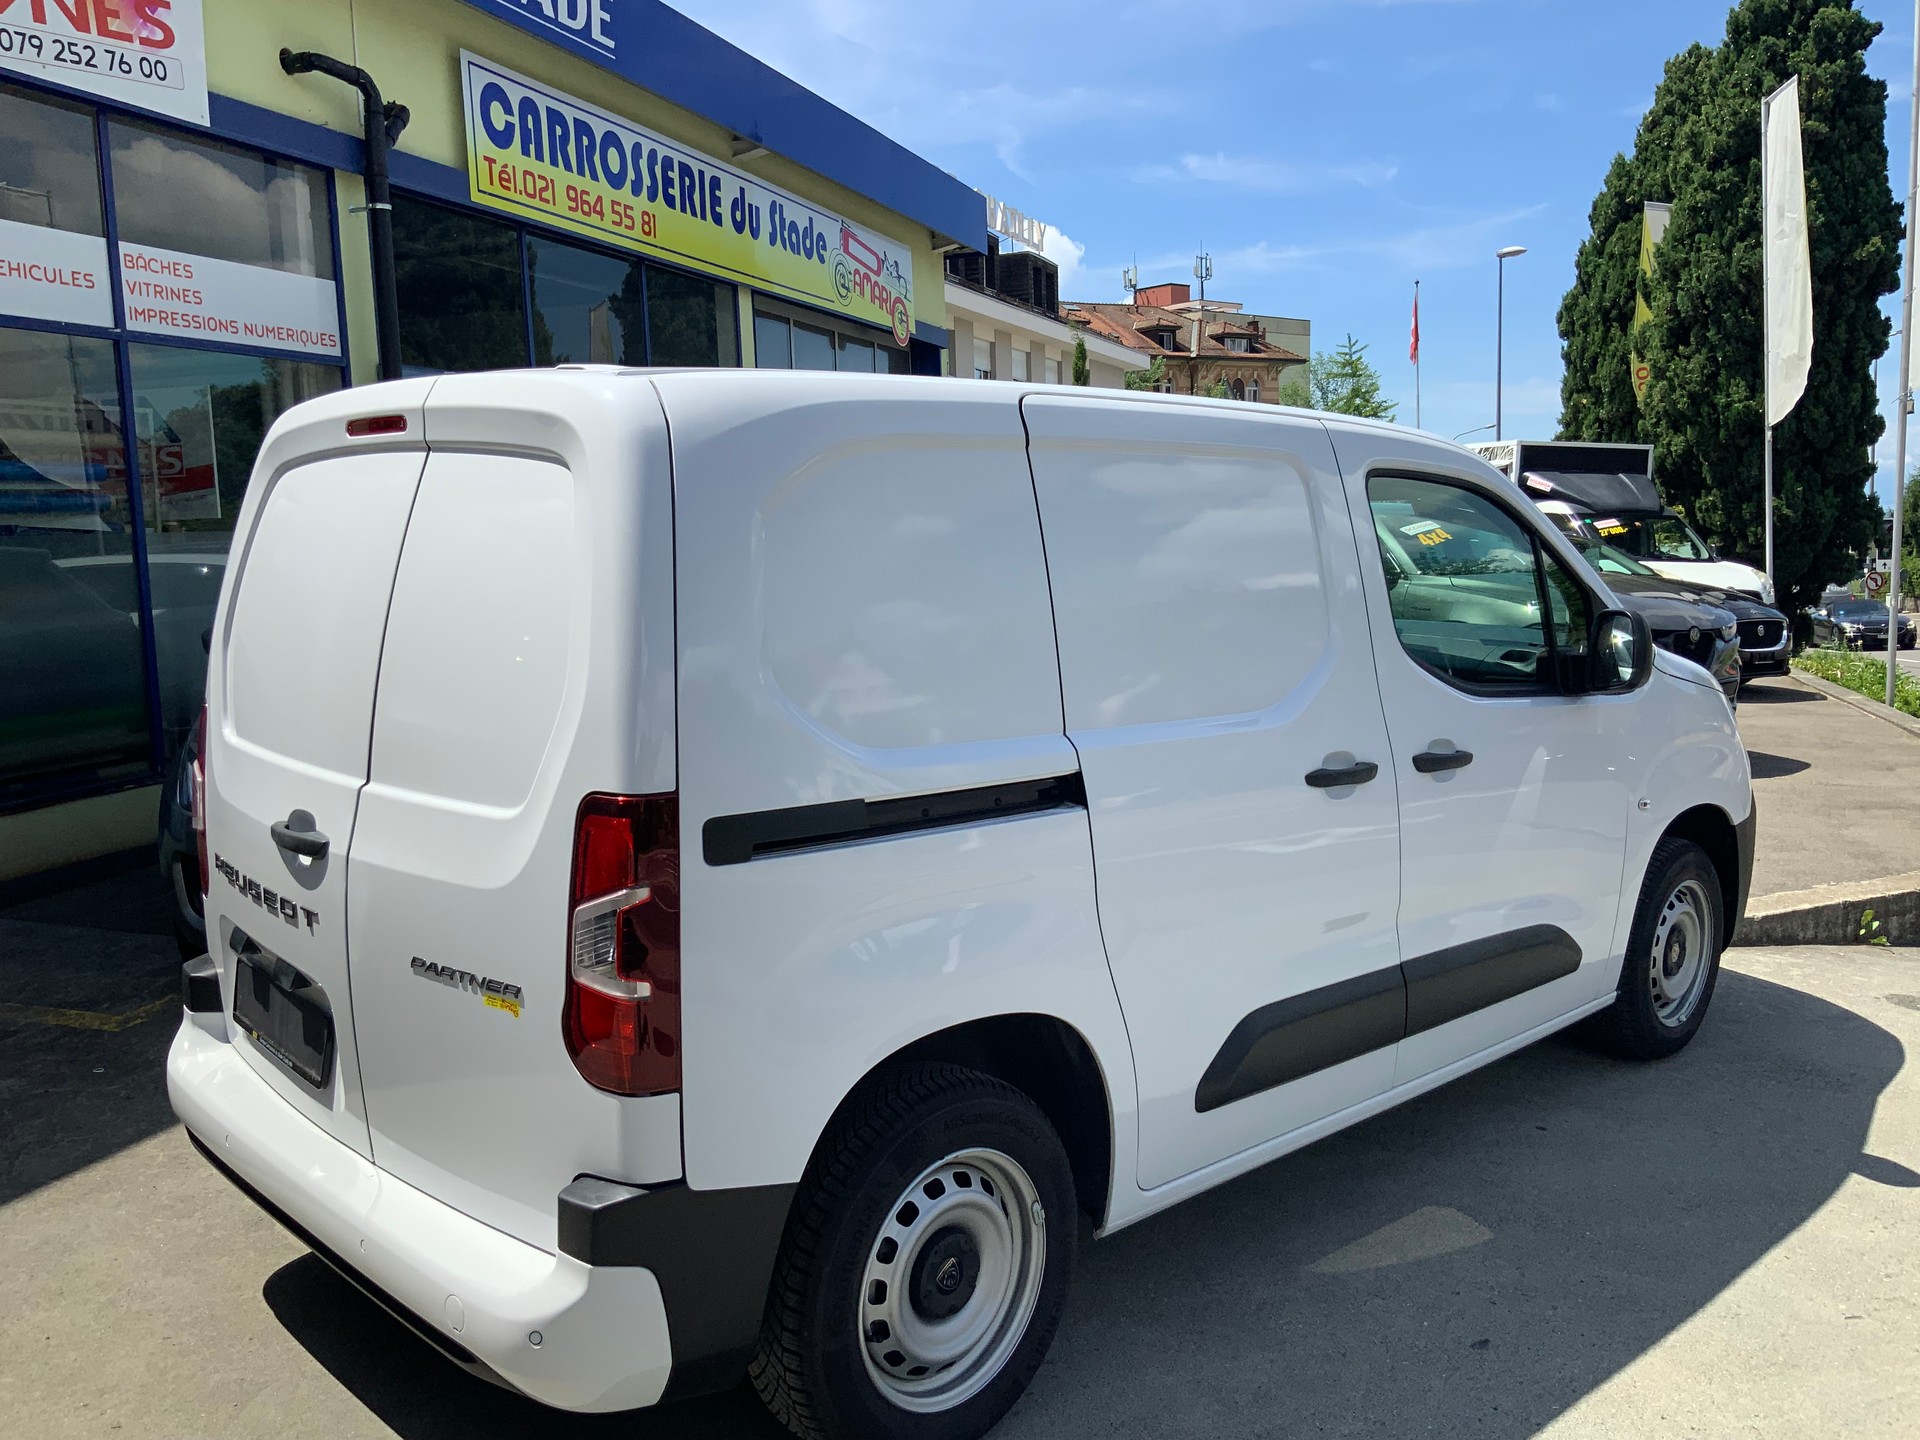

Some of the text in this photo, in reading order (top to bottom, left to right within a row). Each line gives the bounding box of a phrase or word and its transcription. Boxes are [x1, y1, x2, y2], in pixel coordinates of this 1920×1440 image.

[0, 28, 167, 81] 079 252 76 00
[480, 82, 827, 264] CARROSSERIE du Stade
[566, 184, 605, 222] 964
[611, 199, 635, 231] 55
[641, 210, 657, 239] 81
[124, 253, 193, 279] BÂCHES
[126, 279, 203, 305] VITRINES
[128, 306, 337, 347] IMPRESSIONS NUMERIQUES
[215, 853, 320, 928] PEUGEOT
[410, 956, 522, 999] PARTNER
